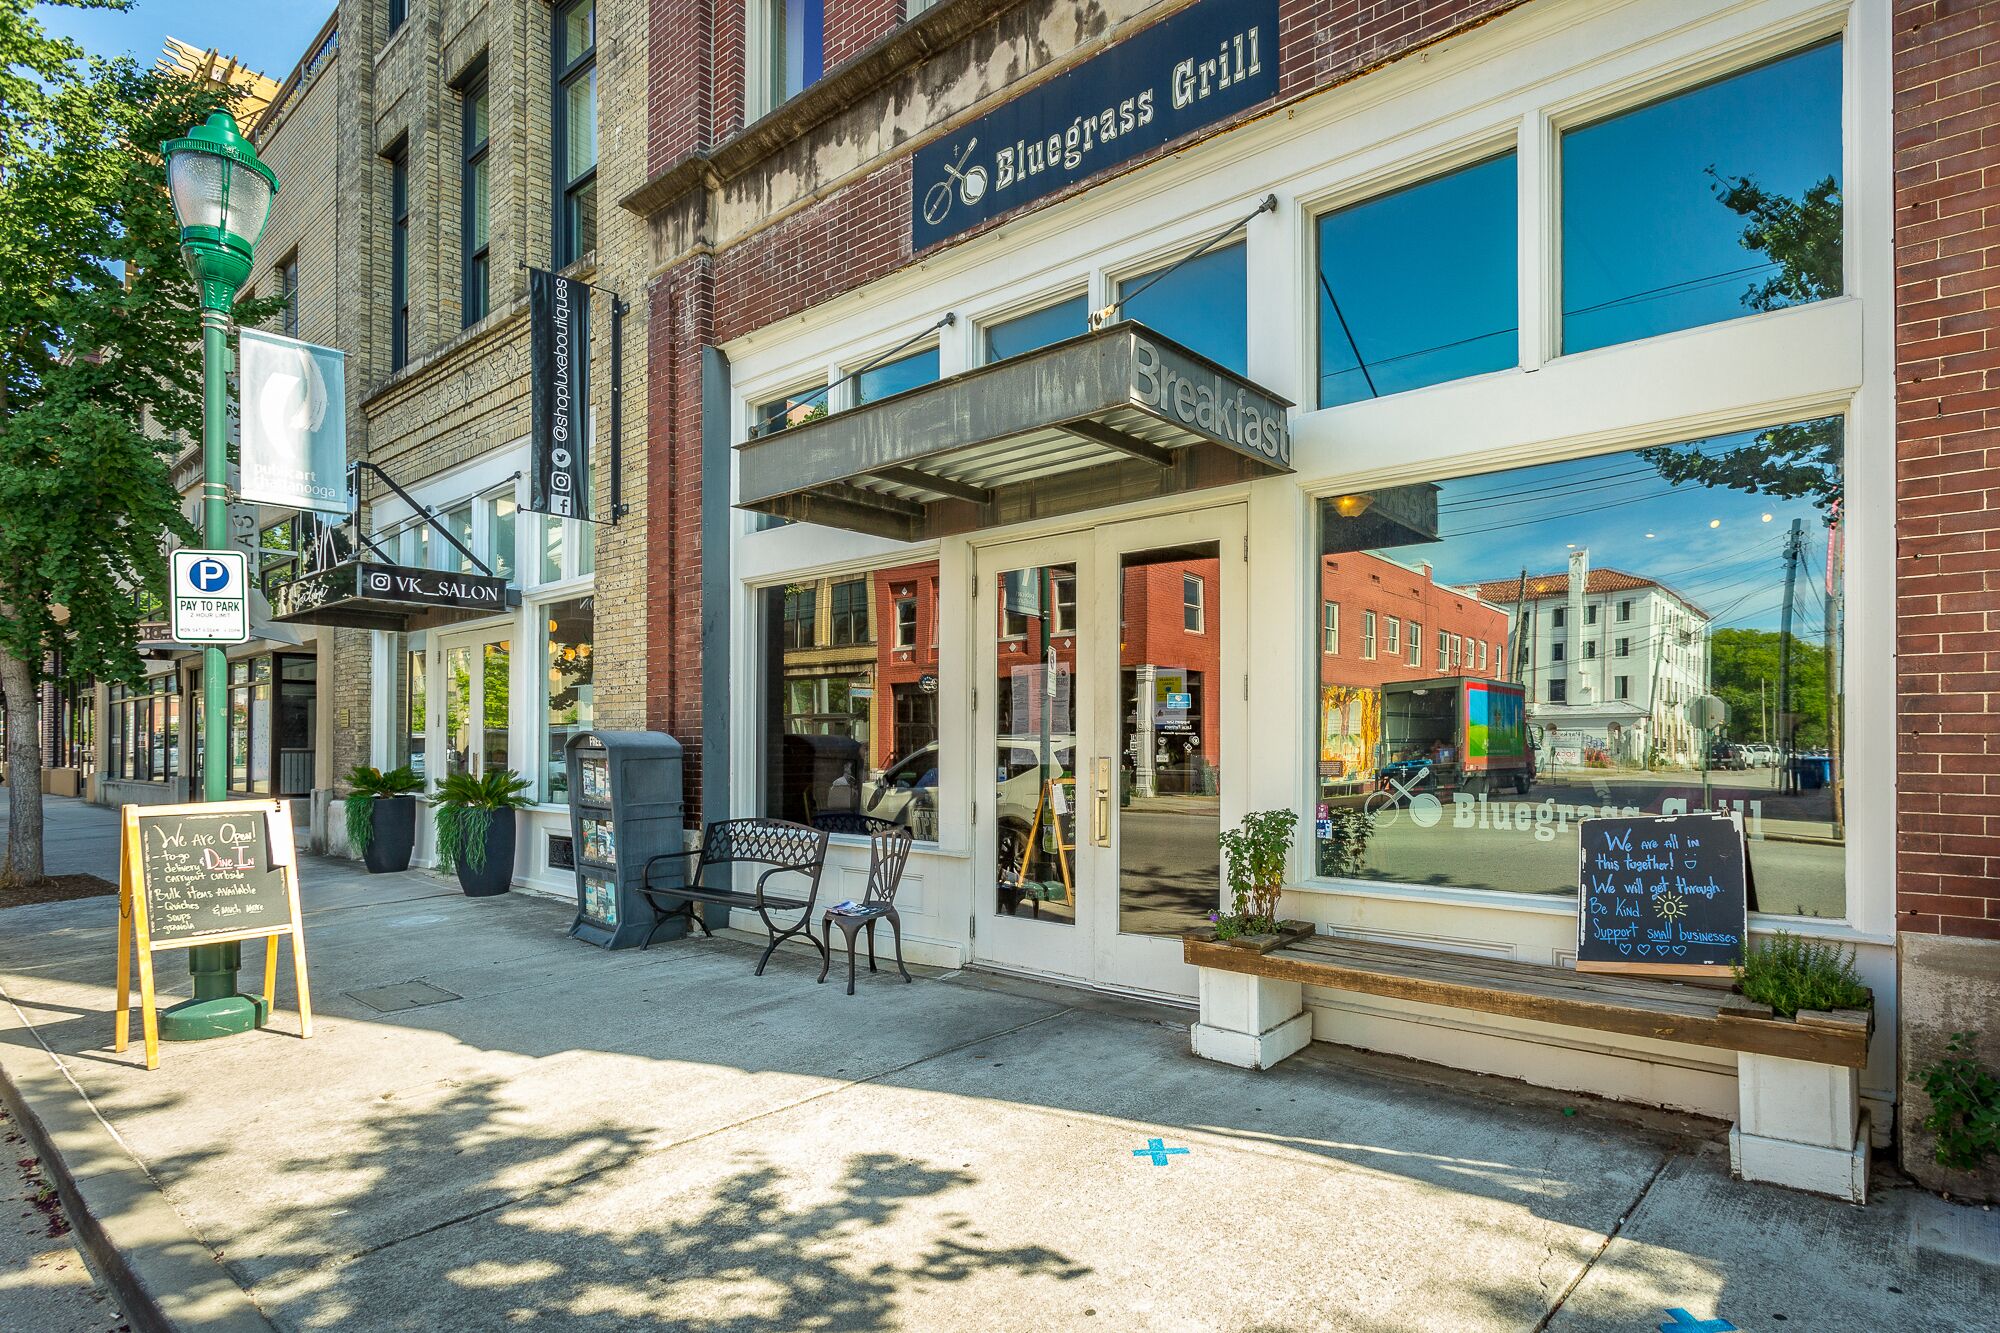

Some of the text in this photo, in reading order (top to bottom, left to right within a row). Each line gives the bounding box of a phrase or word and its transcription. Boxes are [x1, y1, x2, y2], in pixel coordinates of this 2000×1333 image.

[995, 26, 1261, 192] Bluegrass Grill
[552, 278, 570, 442] @shopluxeboutiques
[1130, 332, 1290, 465] Breakfast
[200, 561, 224, 590] P
[395, 575, 498, 601] VK_SALON
[180, 600, 240, 612] PAY TO PARK
[1452, 792, 1640, 842] Bluegrass
[153, 822, 256, 848] We Are Open!
[1604, 828, 1632, 852] We
[1687, 836, 1700, 848] in
[164, 863, 200, 875] delivery
[204, 848, 234, 870] Dine
[1596, 853, 1620, 871] this
[210, 872, 245, 881] curbside
[1592, 874, 1615, 895] We
[1624, 877, 1644, 895] will
[1650, 876, 1670, 900] get
[154, 888, 181, 901] Bulk
[186, 886, 213, 899] items
[164, 900, 200, 911] Quiches
[1589, 896, 1608, 915] Be
[1594, 918, 1738, 945] Support small businesses
